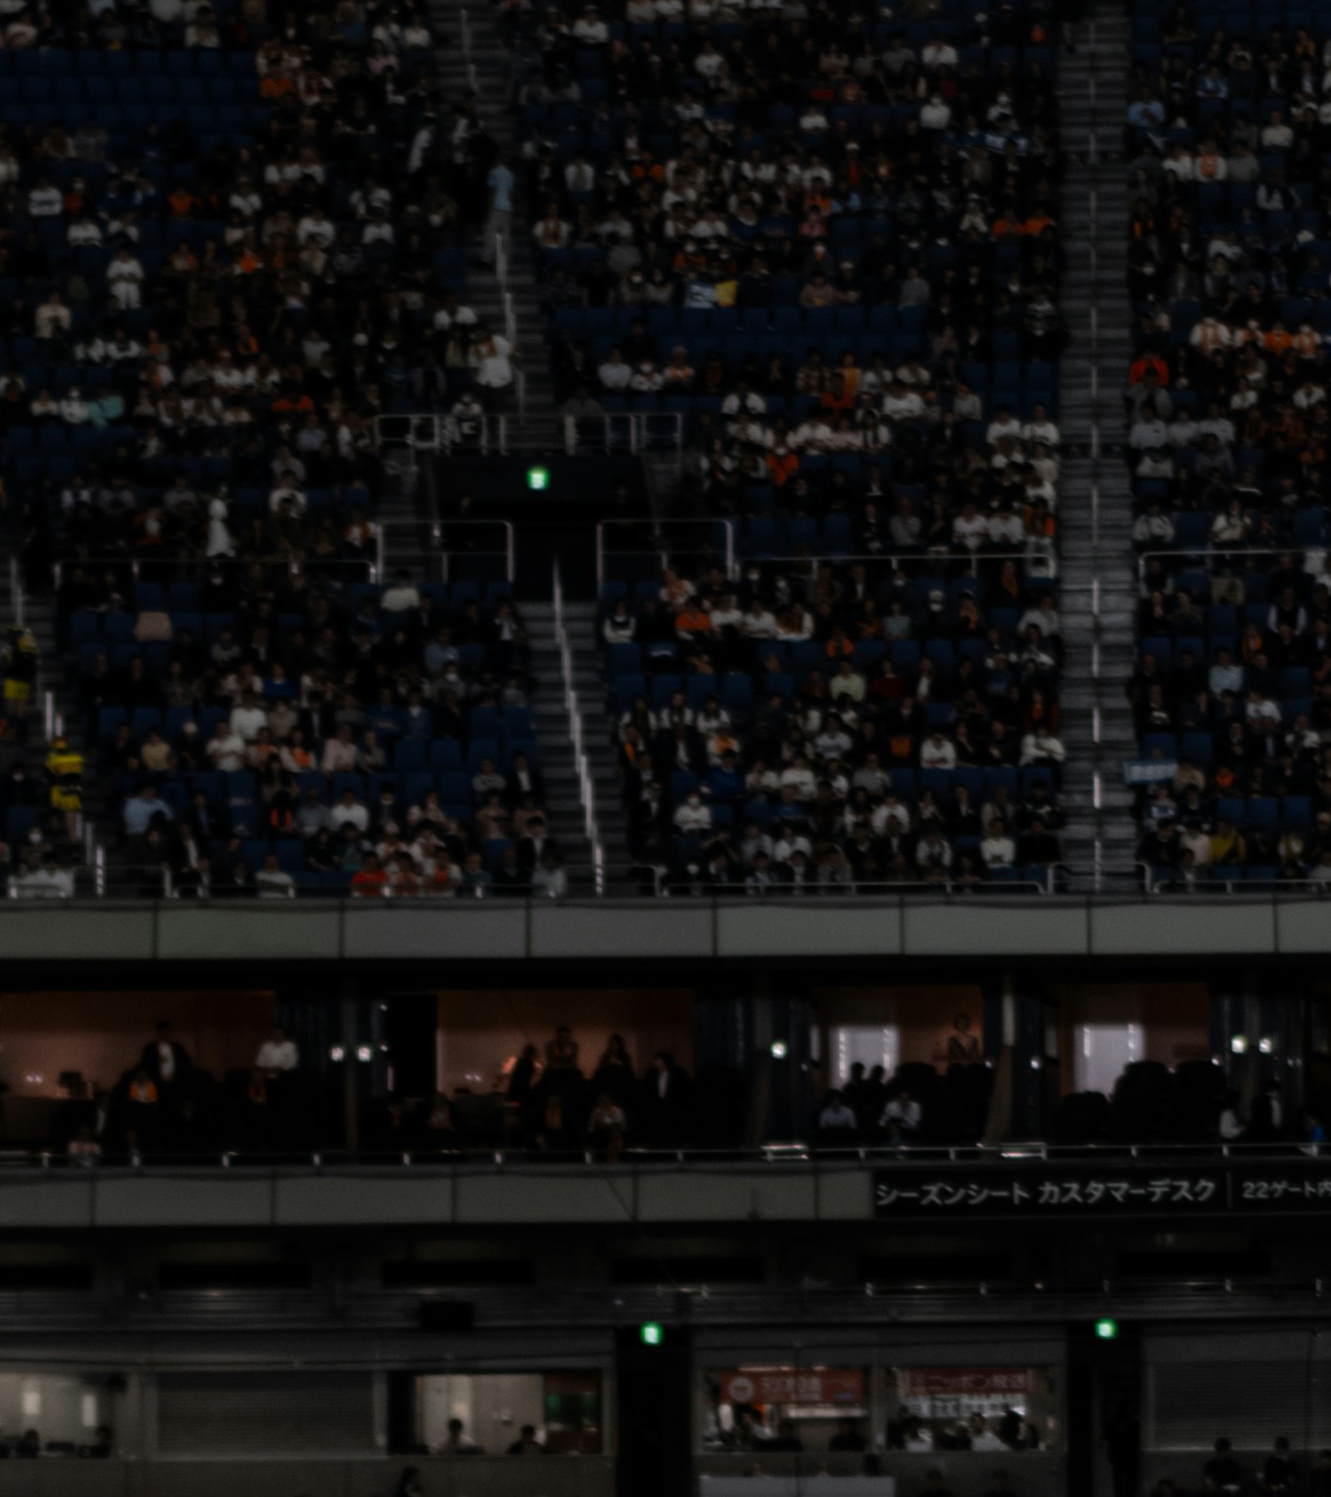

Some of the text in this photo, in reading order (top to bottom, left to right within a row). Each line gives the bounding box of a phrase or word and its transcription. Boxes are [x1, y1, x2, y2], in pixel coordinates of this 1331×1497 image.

[875, 1181, 1030, 1206] シーズンシート
[1037, 1178, 1217, 1204] カスタマーデスク
